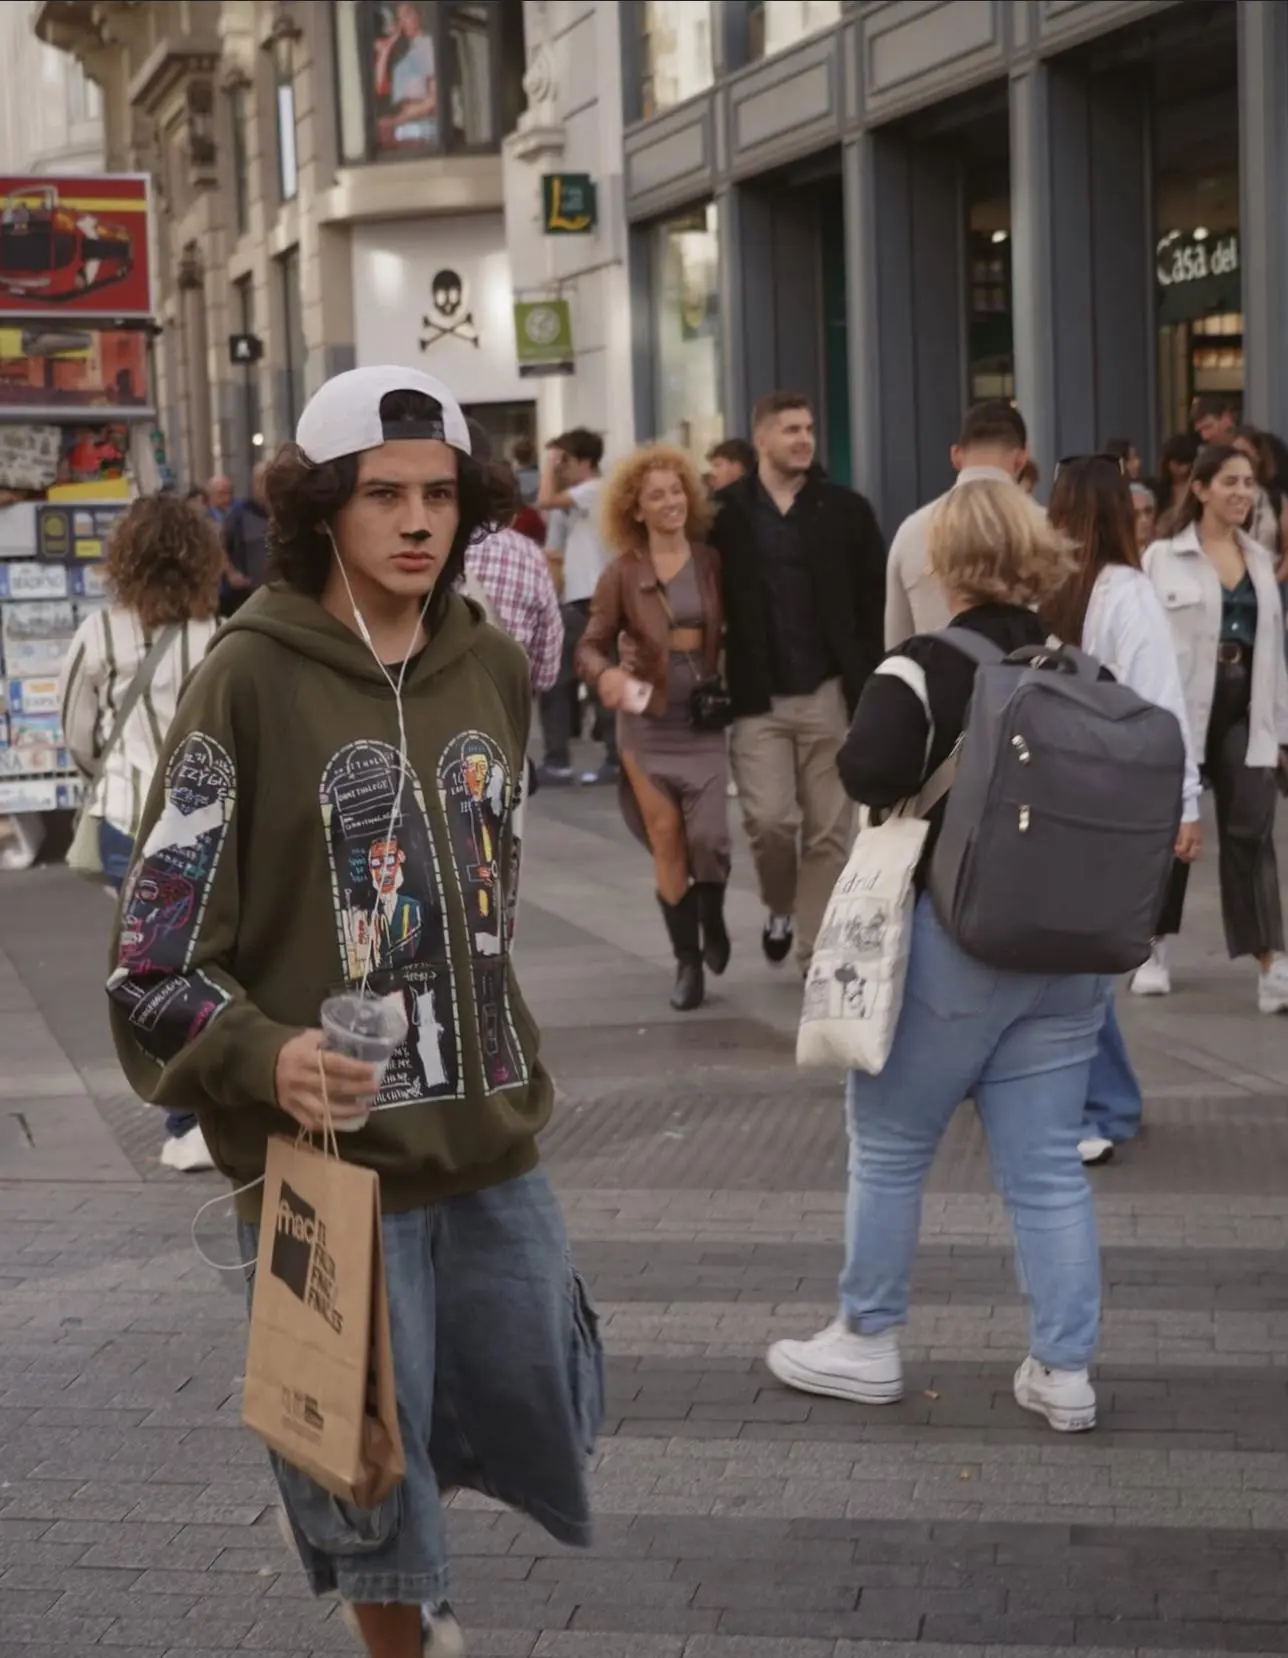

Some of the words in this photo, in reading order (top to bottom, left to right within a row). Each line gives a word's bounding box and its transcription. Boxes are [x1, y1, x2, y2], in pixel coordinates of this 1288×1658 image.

[1156, 230, 1208, 286] Casa
[1211, 236, 1238, 276] del
[276, 1198, 317, 1245] fnac
